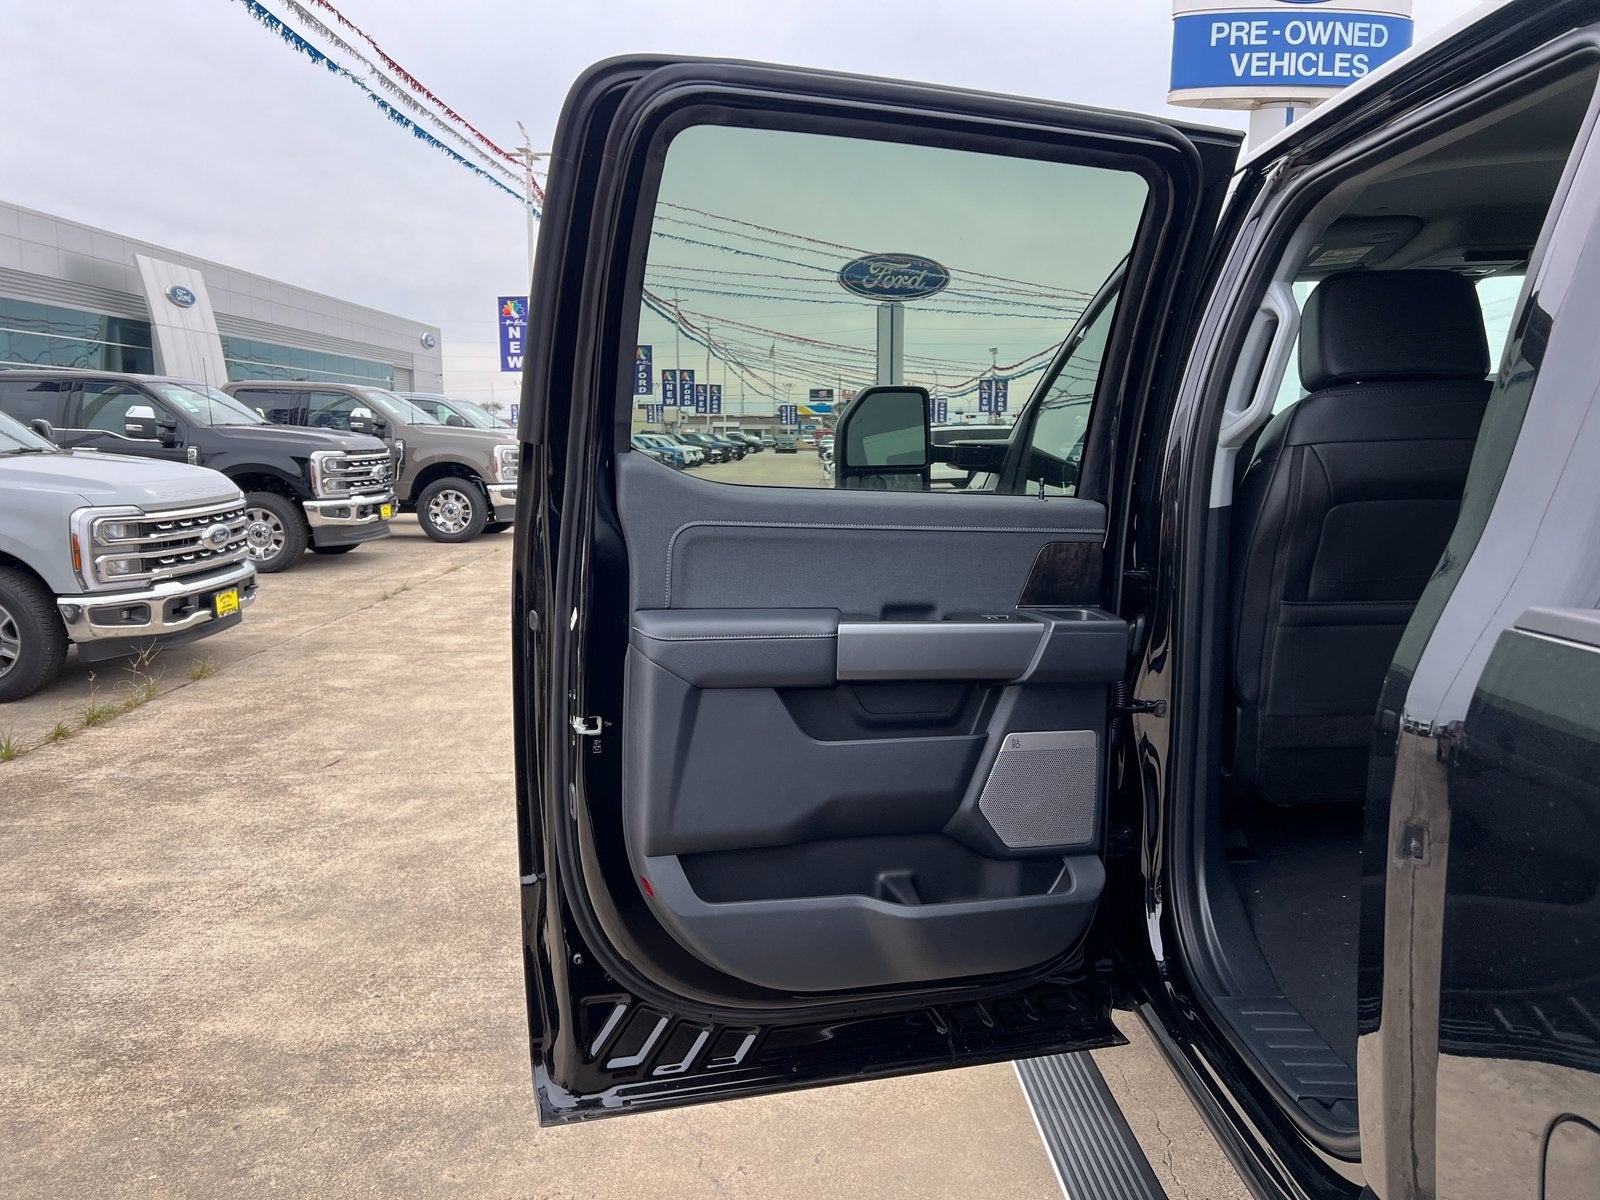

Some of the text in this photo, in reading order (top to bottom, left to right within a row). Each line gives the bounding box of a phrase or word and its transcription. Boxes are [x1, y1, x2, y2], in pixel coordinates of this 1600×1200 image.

[1230, 52, 1369, 78] VEHICLES
[862, 261, 927, 289] Ford
[507, 326, 524, 369] NEW
[638, 364, 647, 394] FORD
[665, 383, 675, 405] NEW
[683, 384, 691, 406] FORD
[981, 392, 989, 411] NEW
